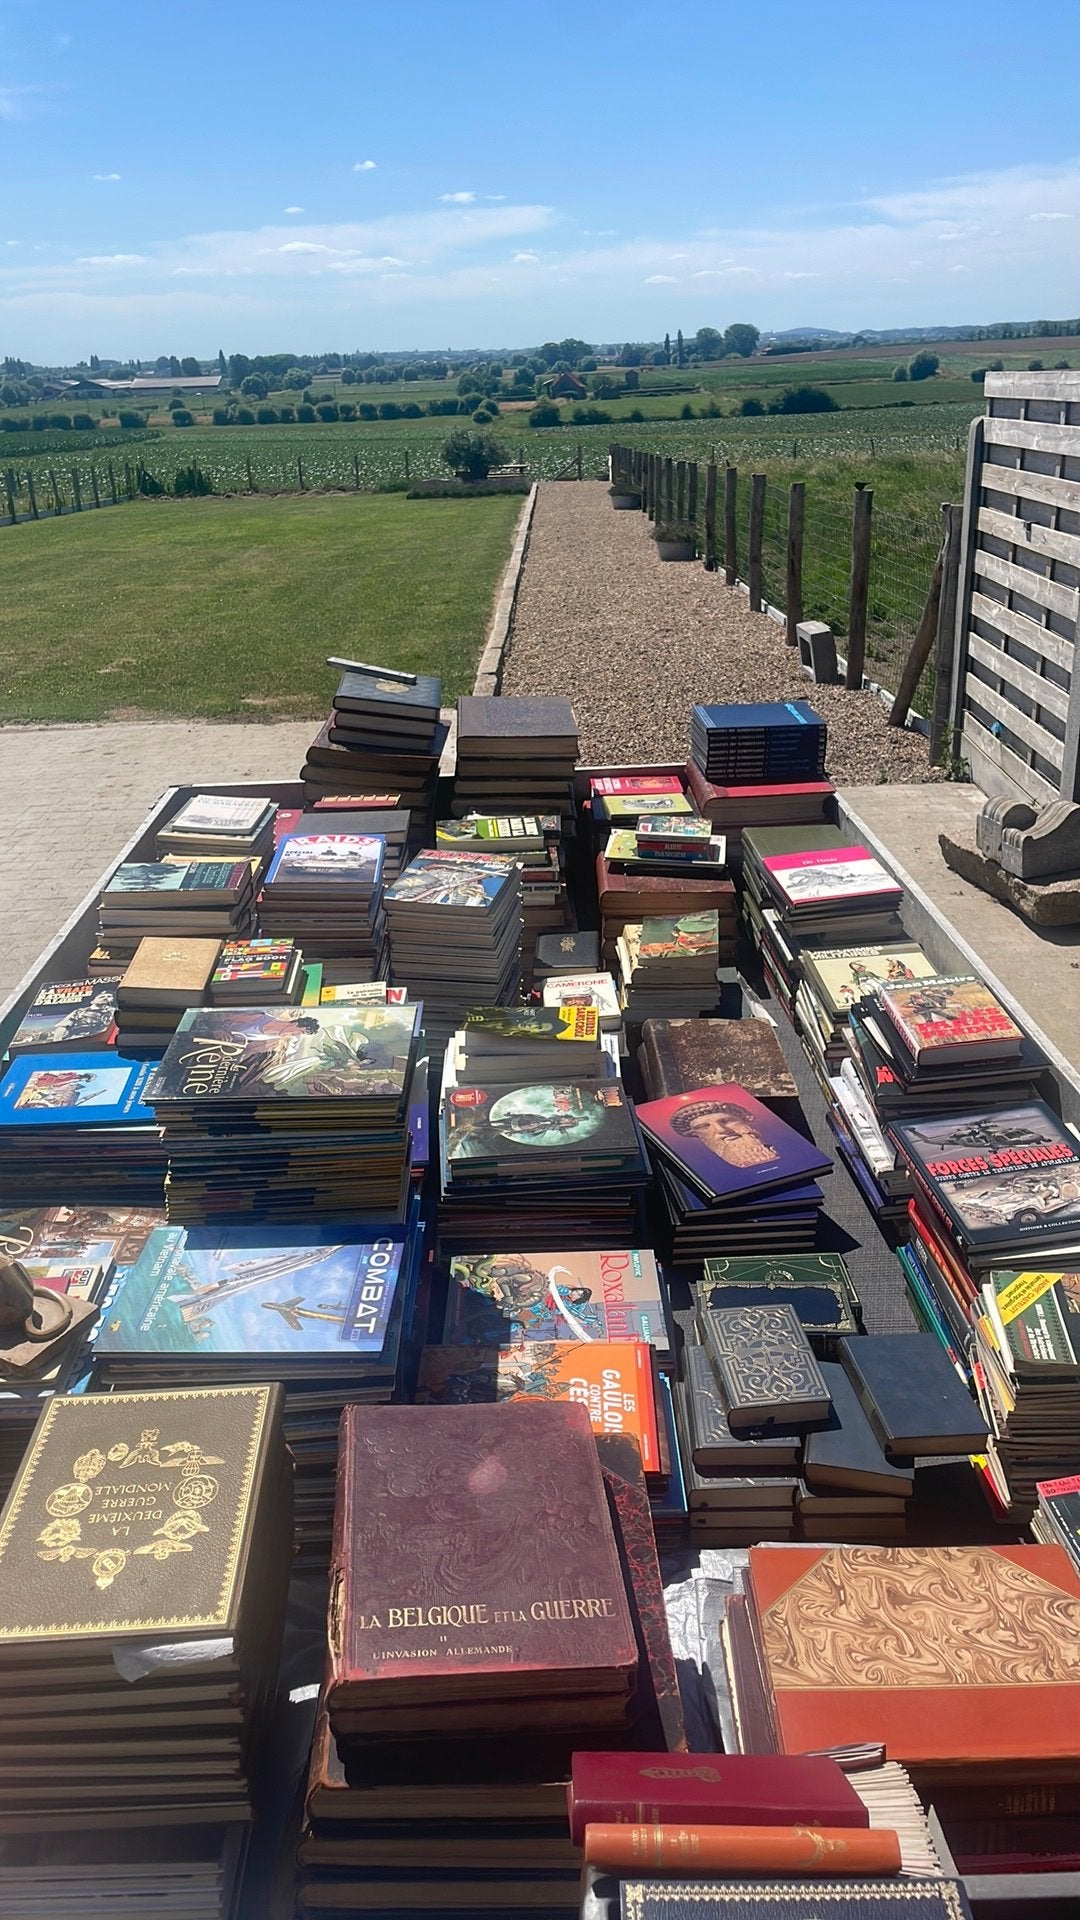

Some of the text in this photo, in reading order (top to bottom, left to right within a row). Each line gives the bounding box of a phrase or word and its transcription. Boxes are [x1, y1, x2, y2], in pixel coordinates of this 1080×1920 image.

[297, 834, 375, 845] RAIDS
[811, 950, 880, 960] MILITAIRES
[546, 979, 609, 989] CAMERONE
[886, 974, 975, 990] Jean Mabire
[179, 1031, 249, 1095] Reine
[925, 1143, 1074, 1177] FORCES SPÉCIALES
[150, 1231, 178, 1277] au Vietnam
[353, 1237, 394, 1335] COMBAT
[140, 1283, 170, 1331] américaine
[589, 1384, 602, 1422] CONTRE
[623, 1393, 635, 1412] LES
[94, 1482, 173, 1496] MONDIALE
[101, 1496, 157, 1508] GUERRE
[112, 1526, 130, 1536] LA
[359, 1598, 617, 1630] LA BELGIQUE ET LA GUERRE
[373, 1644, 513, 1661] L'INVASION ALLEMANDE
